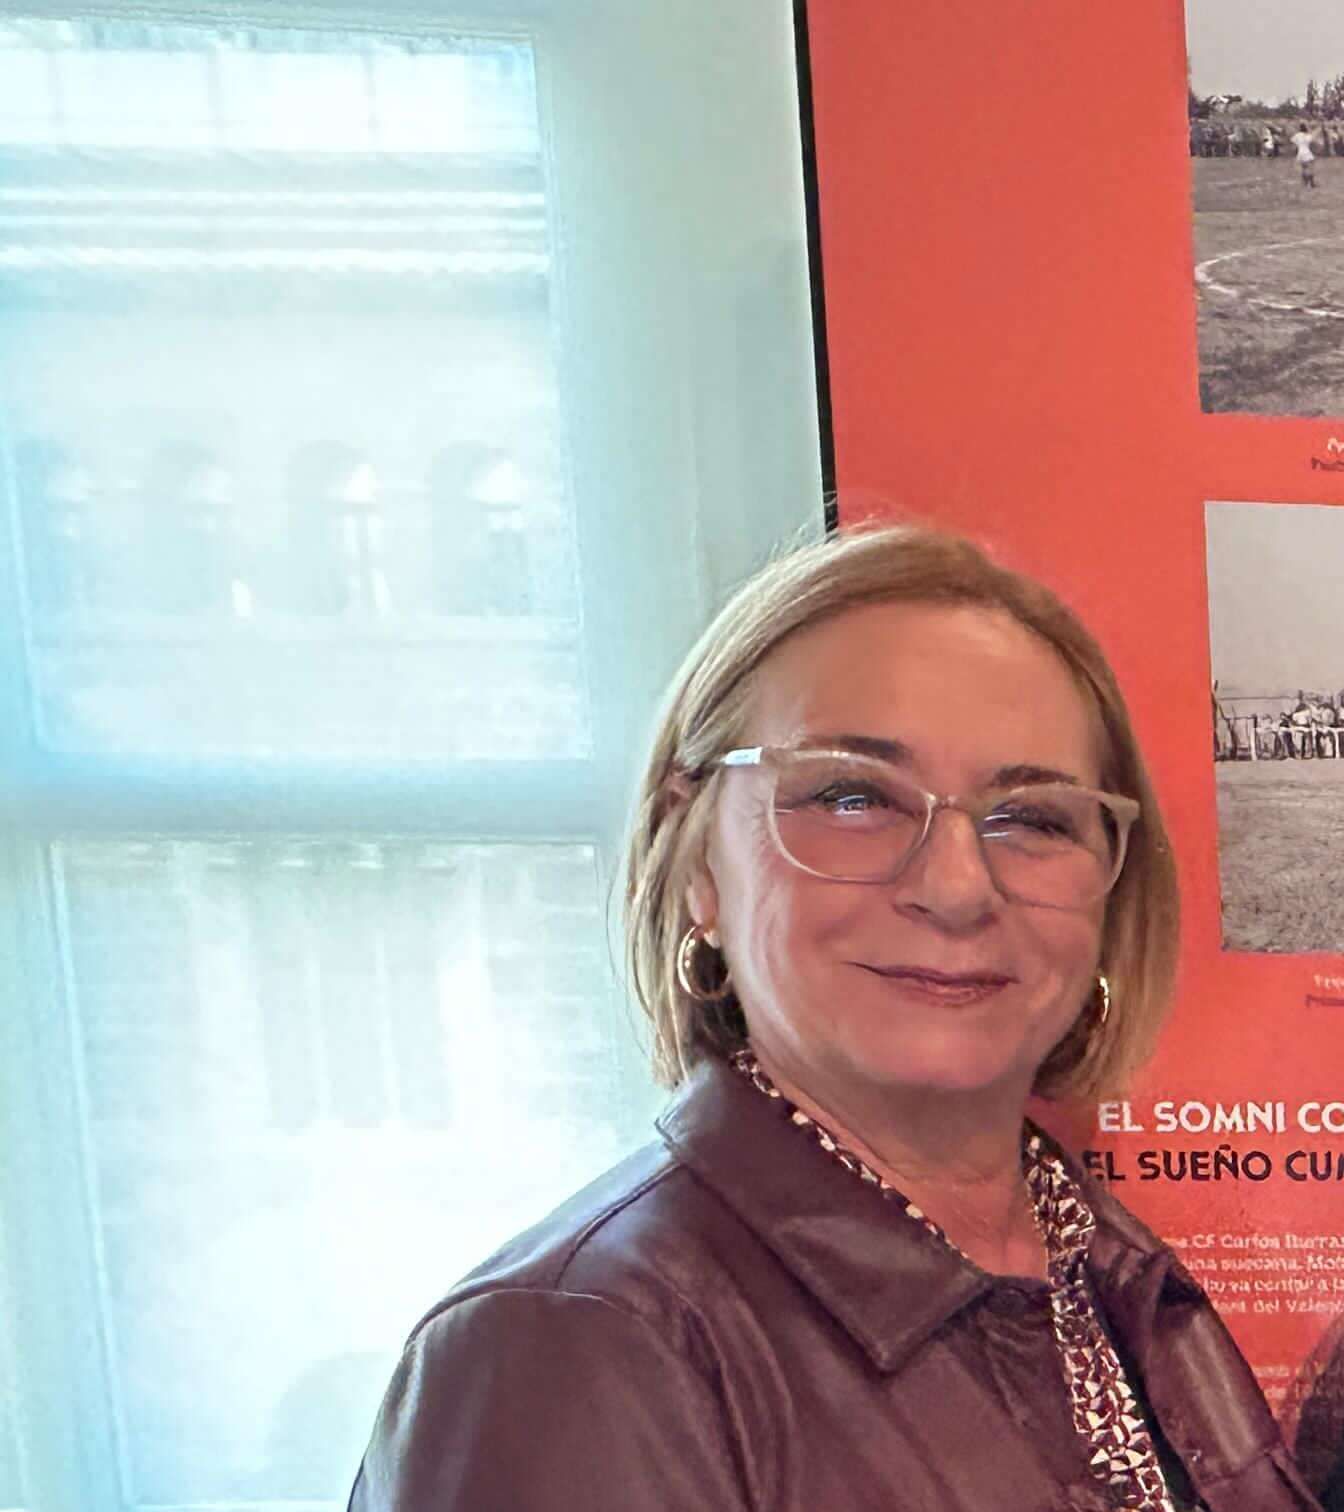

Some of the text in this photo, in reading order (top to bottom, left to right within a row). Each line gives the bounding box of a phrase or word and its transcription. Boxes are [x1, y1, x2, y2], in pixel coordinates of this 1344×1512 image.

[1097, 1101, 1145, 1133] EL
[1153, 1100, 1287, 1134] SOMNI
[1082, 1149, 1127, 1181] EL
[1137, 1143, 1273, 1182] SUEÑO
